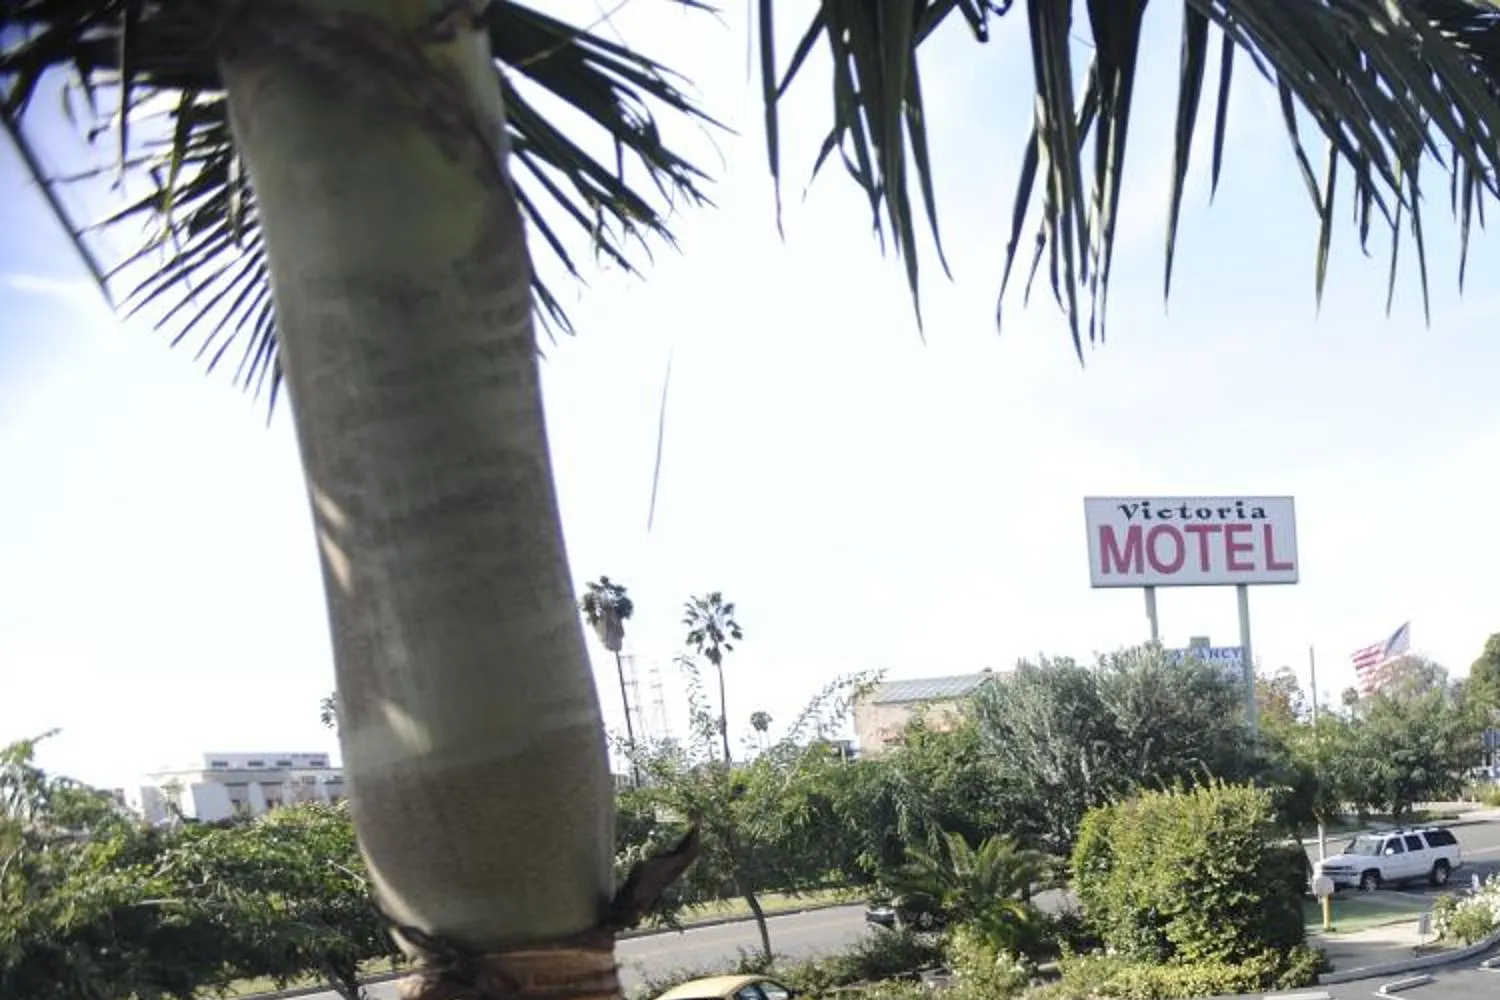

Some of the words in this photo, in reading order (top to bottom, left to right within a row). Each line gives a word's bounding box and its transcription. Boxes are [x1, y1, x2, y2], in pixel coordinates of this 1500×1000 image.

[1118, 501, 1267, 520] Victoria
[1099, 524, 1294, 574] MOTEL
[1164, 647, 1241, 660] AANCY
